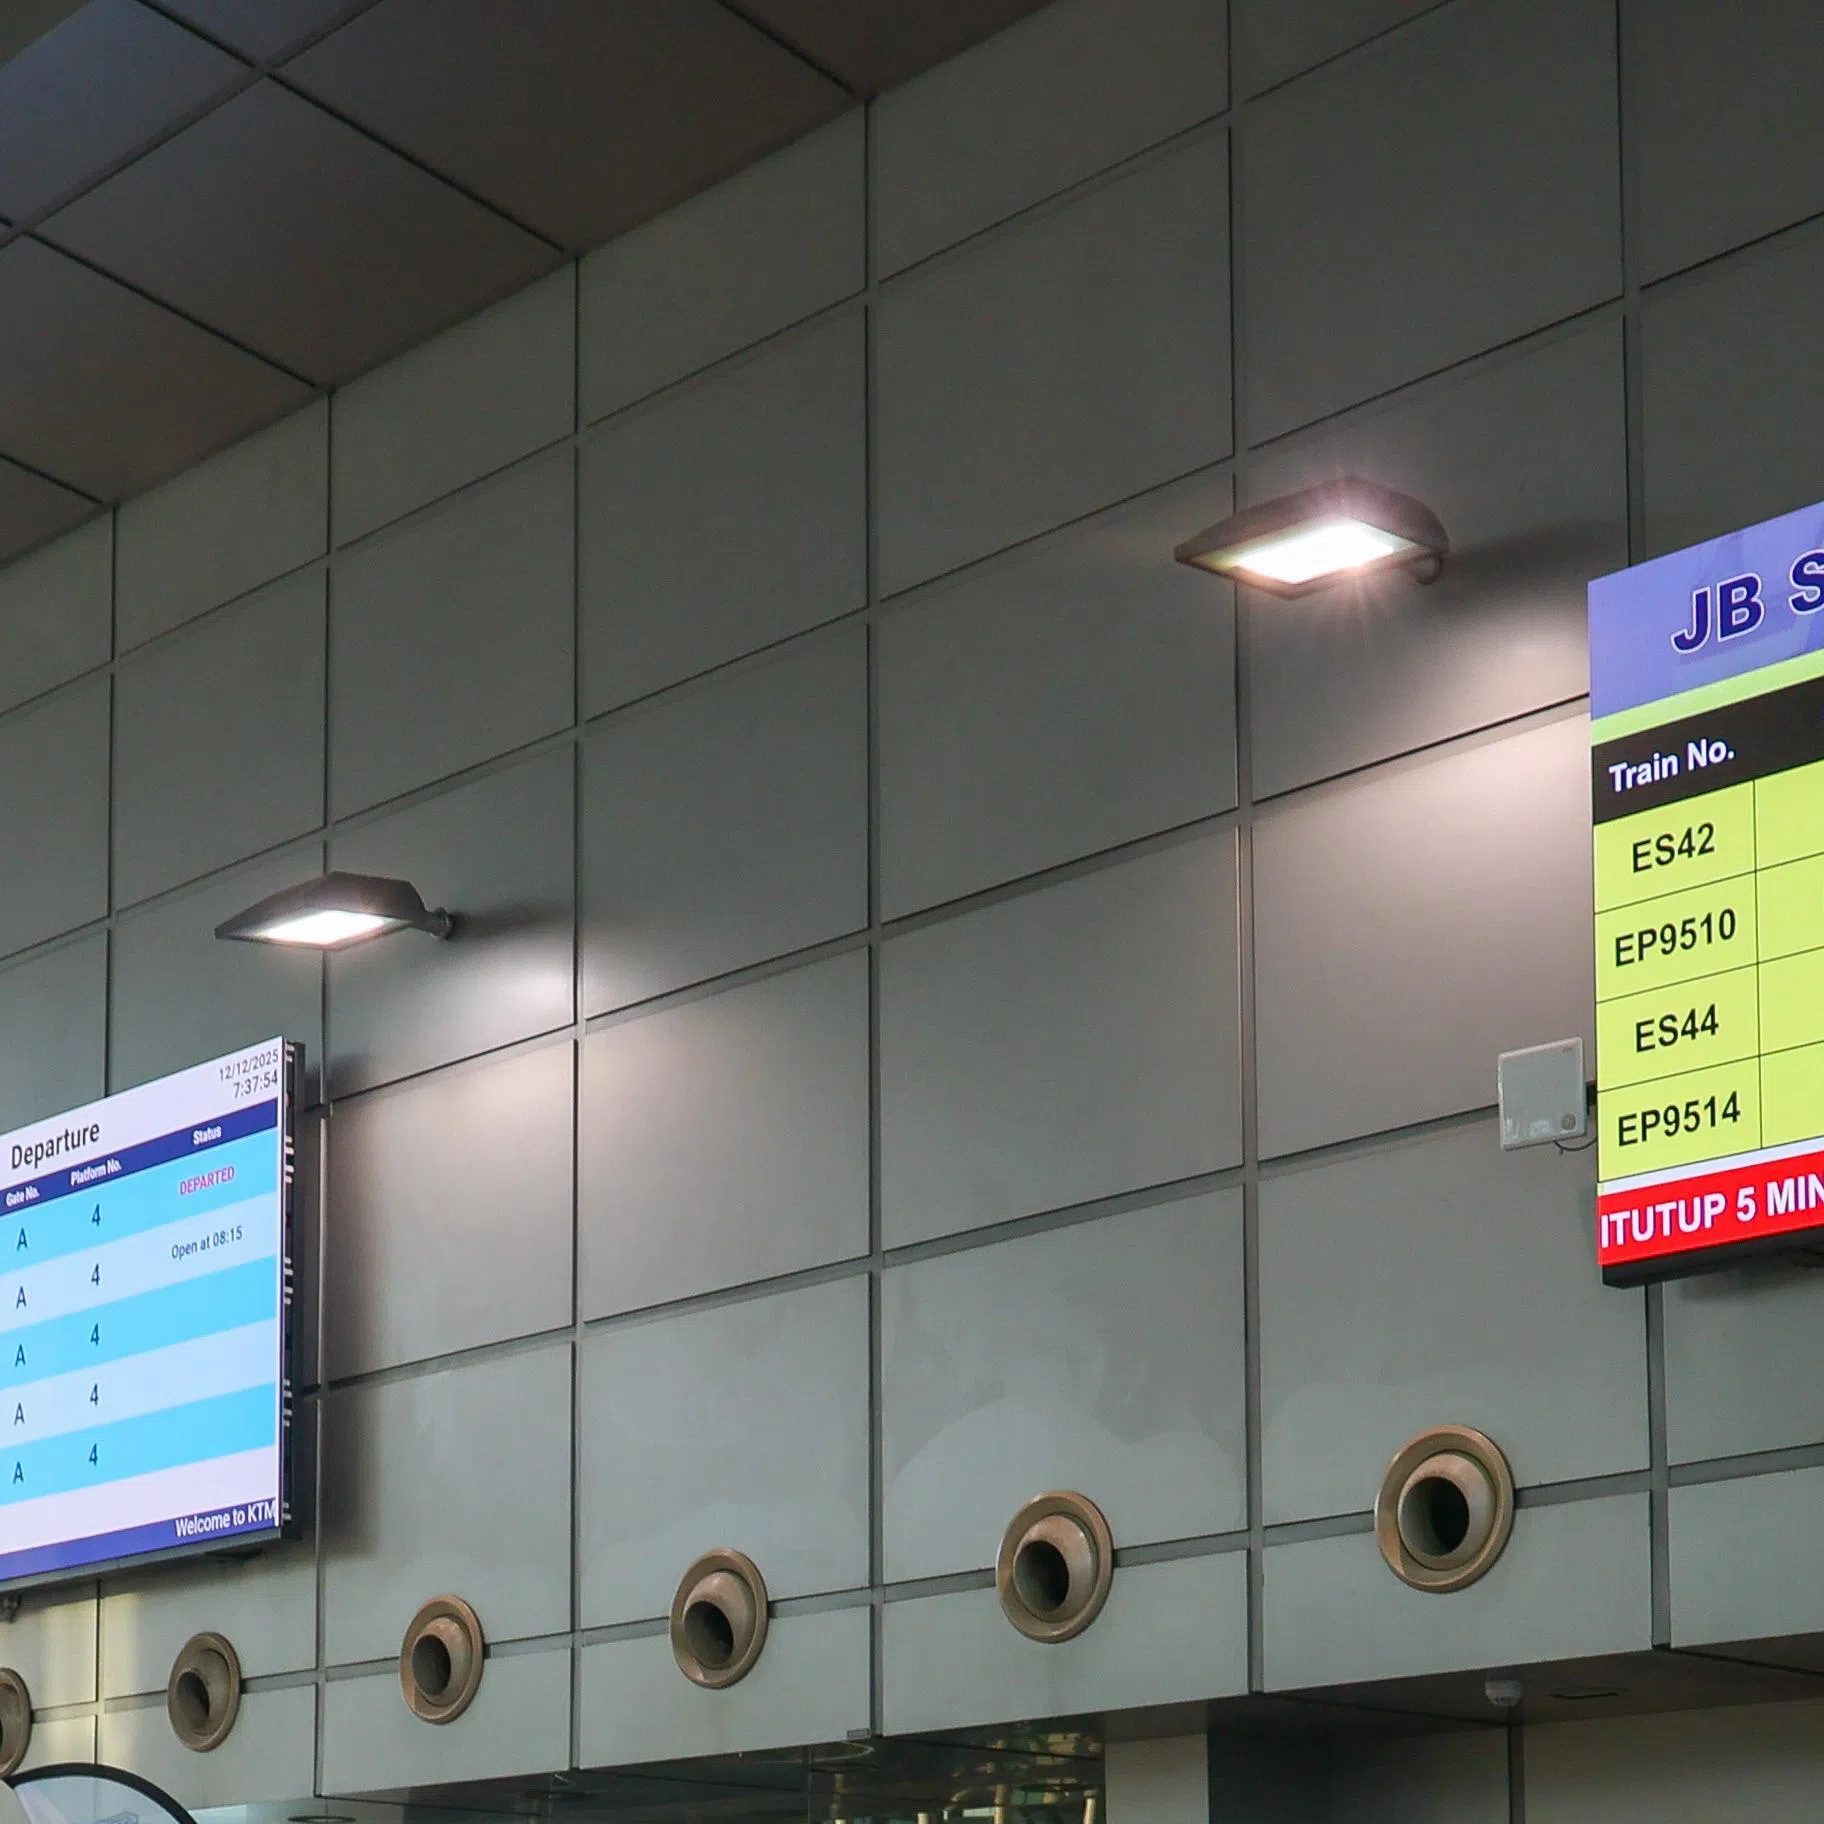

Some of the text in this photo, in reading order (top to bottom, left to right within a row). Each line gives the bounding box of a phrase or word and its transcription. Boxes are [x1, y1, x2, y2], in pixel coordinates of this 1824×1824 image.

[1669, 572, 1766, 656] JB
[1607, 734, 1736, 797] Train No.
[1630, 821, 1717, 874] ES42
[1612, 906, 1739, 971] EP9510
[1632, 1002, 1721, 1055] ES44
[218, 1049, 279, 1082] 12/12/2025
[233, 1072, 279, 1100] 7:37:54
[1616, 1090, 1741, 1151] EP9514
[10, 1122, 101, 1170] Departure
[192, 1124, 222, 1146] Status
[70, 1158, 122, 1186] Platform No.
[179, 1165, 235, 1196] DEPARTED
[91, 1204, 102, 1227] 4
[1598, 1192, 1729, 1253] ITUTUP
[1735, 1183, 1758, 1222] 5
[16, 1228, 29, 1251] A
[170, 1225, 243, 1263] Open at 08:15
[90, 1264, 101, 1286] 4
[15, 1286, 27, 1309] A
[90, 1323, 101, 1346] 4
[14, 1345, 26, 1367] A
[89, 1383, 100, 1406] 4
[13, 1404, 25, 1425] A
[89, 1444, 99, 1466] 4
[12, 1462, 24, 1484] A
[175, 1507, 230, 1538] Welcome
[232, 1506, 246, 1526] to
